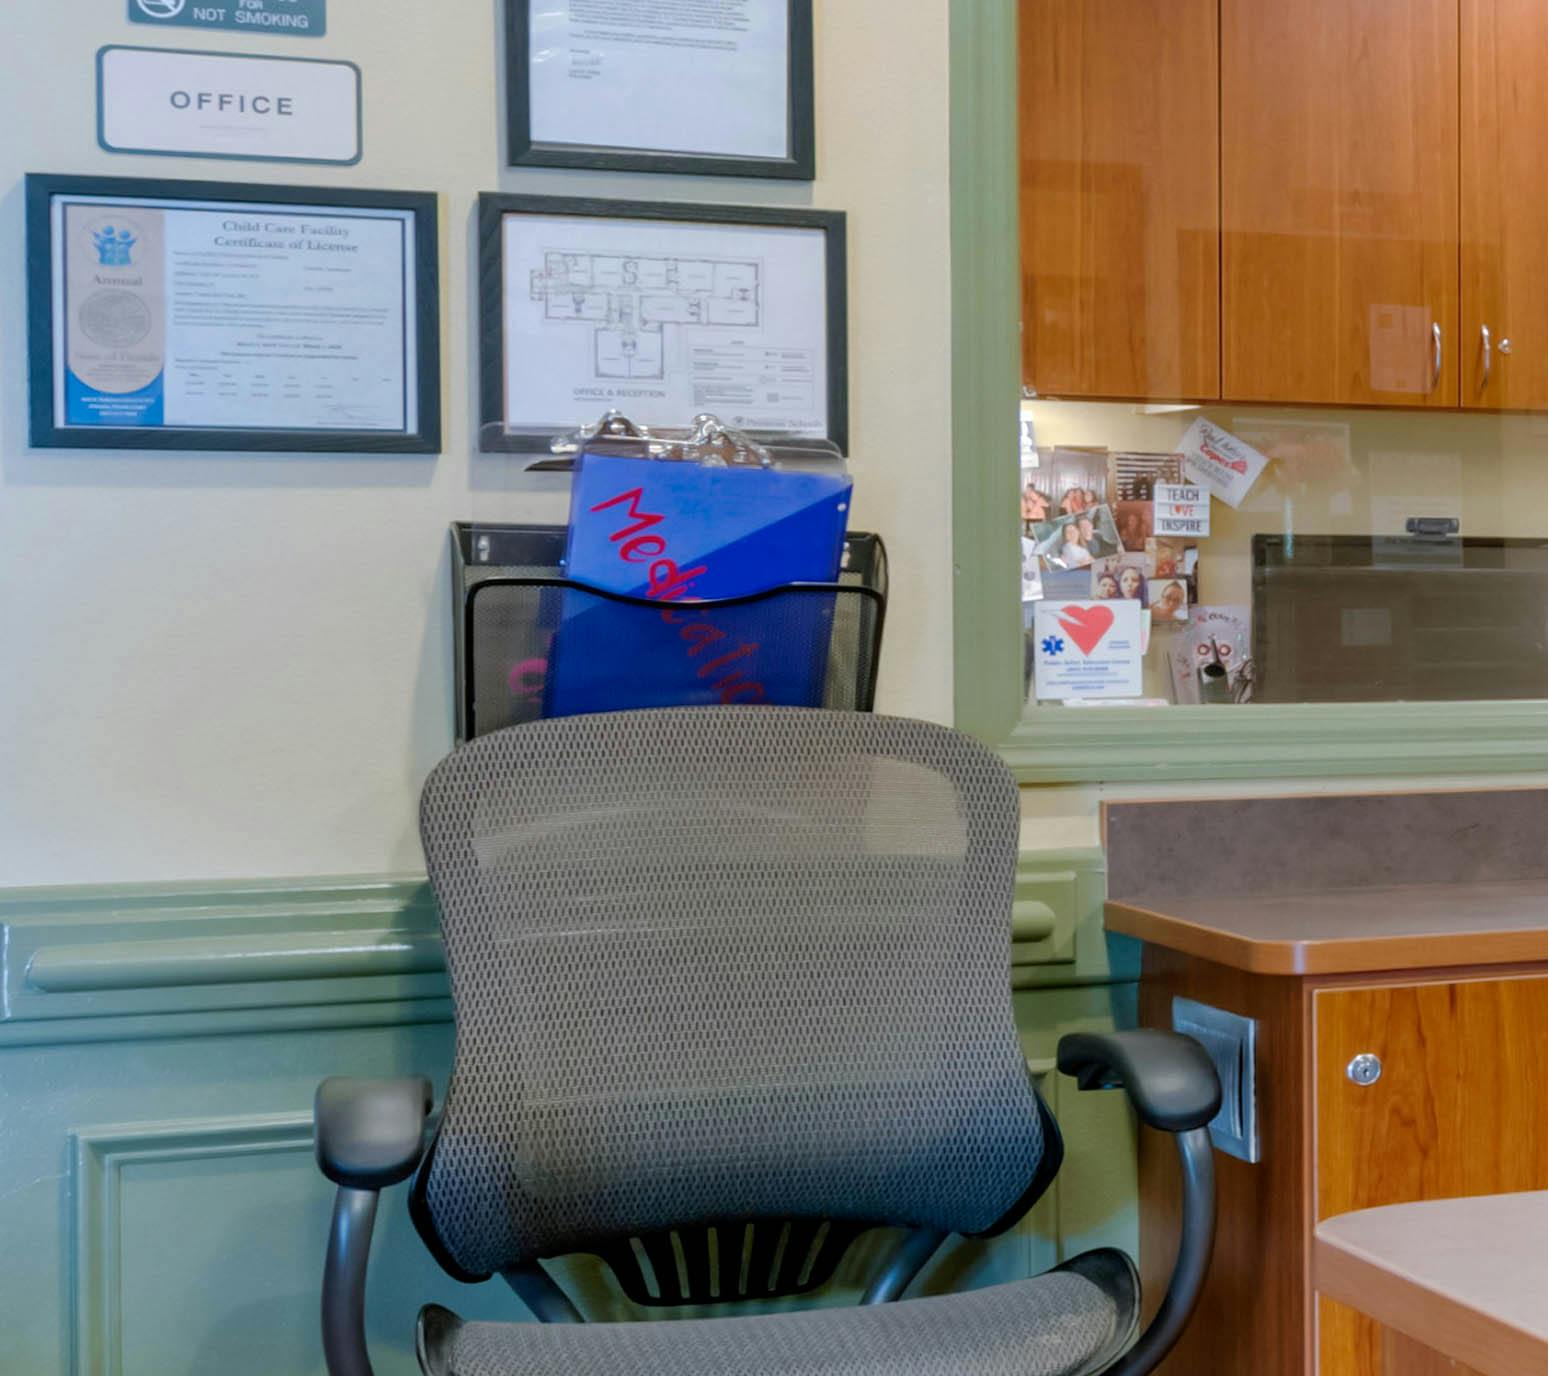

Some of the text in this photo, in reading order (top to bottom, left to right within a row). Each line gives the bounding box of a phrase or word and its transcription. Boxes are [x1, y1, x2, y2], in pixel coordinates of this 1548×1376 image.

[239, 0, 264, 10] FOR
[193, 7, 310, 28] NOT SMOKING
[170, 90, 293, 116] OFFICE
[1167, 488, 1200, 502] TEACH
[1161, 519, 1202, 532] INSPIRE
[590, 486, 771, 706] Medicatio
